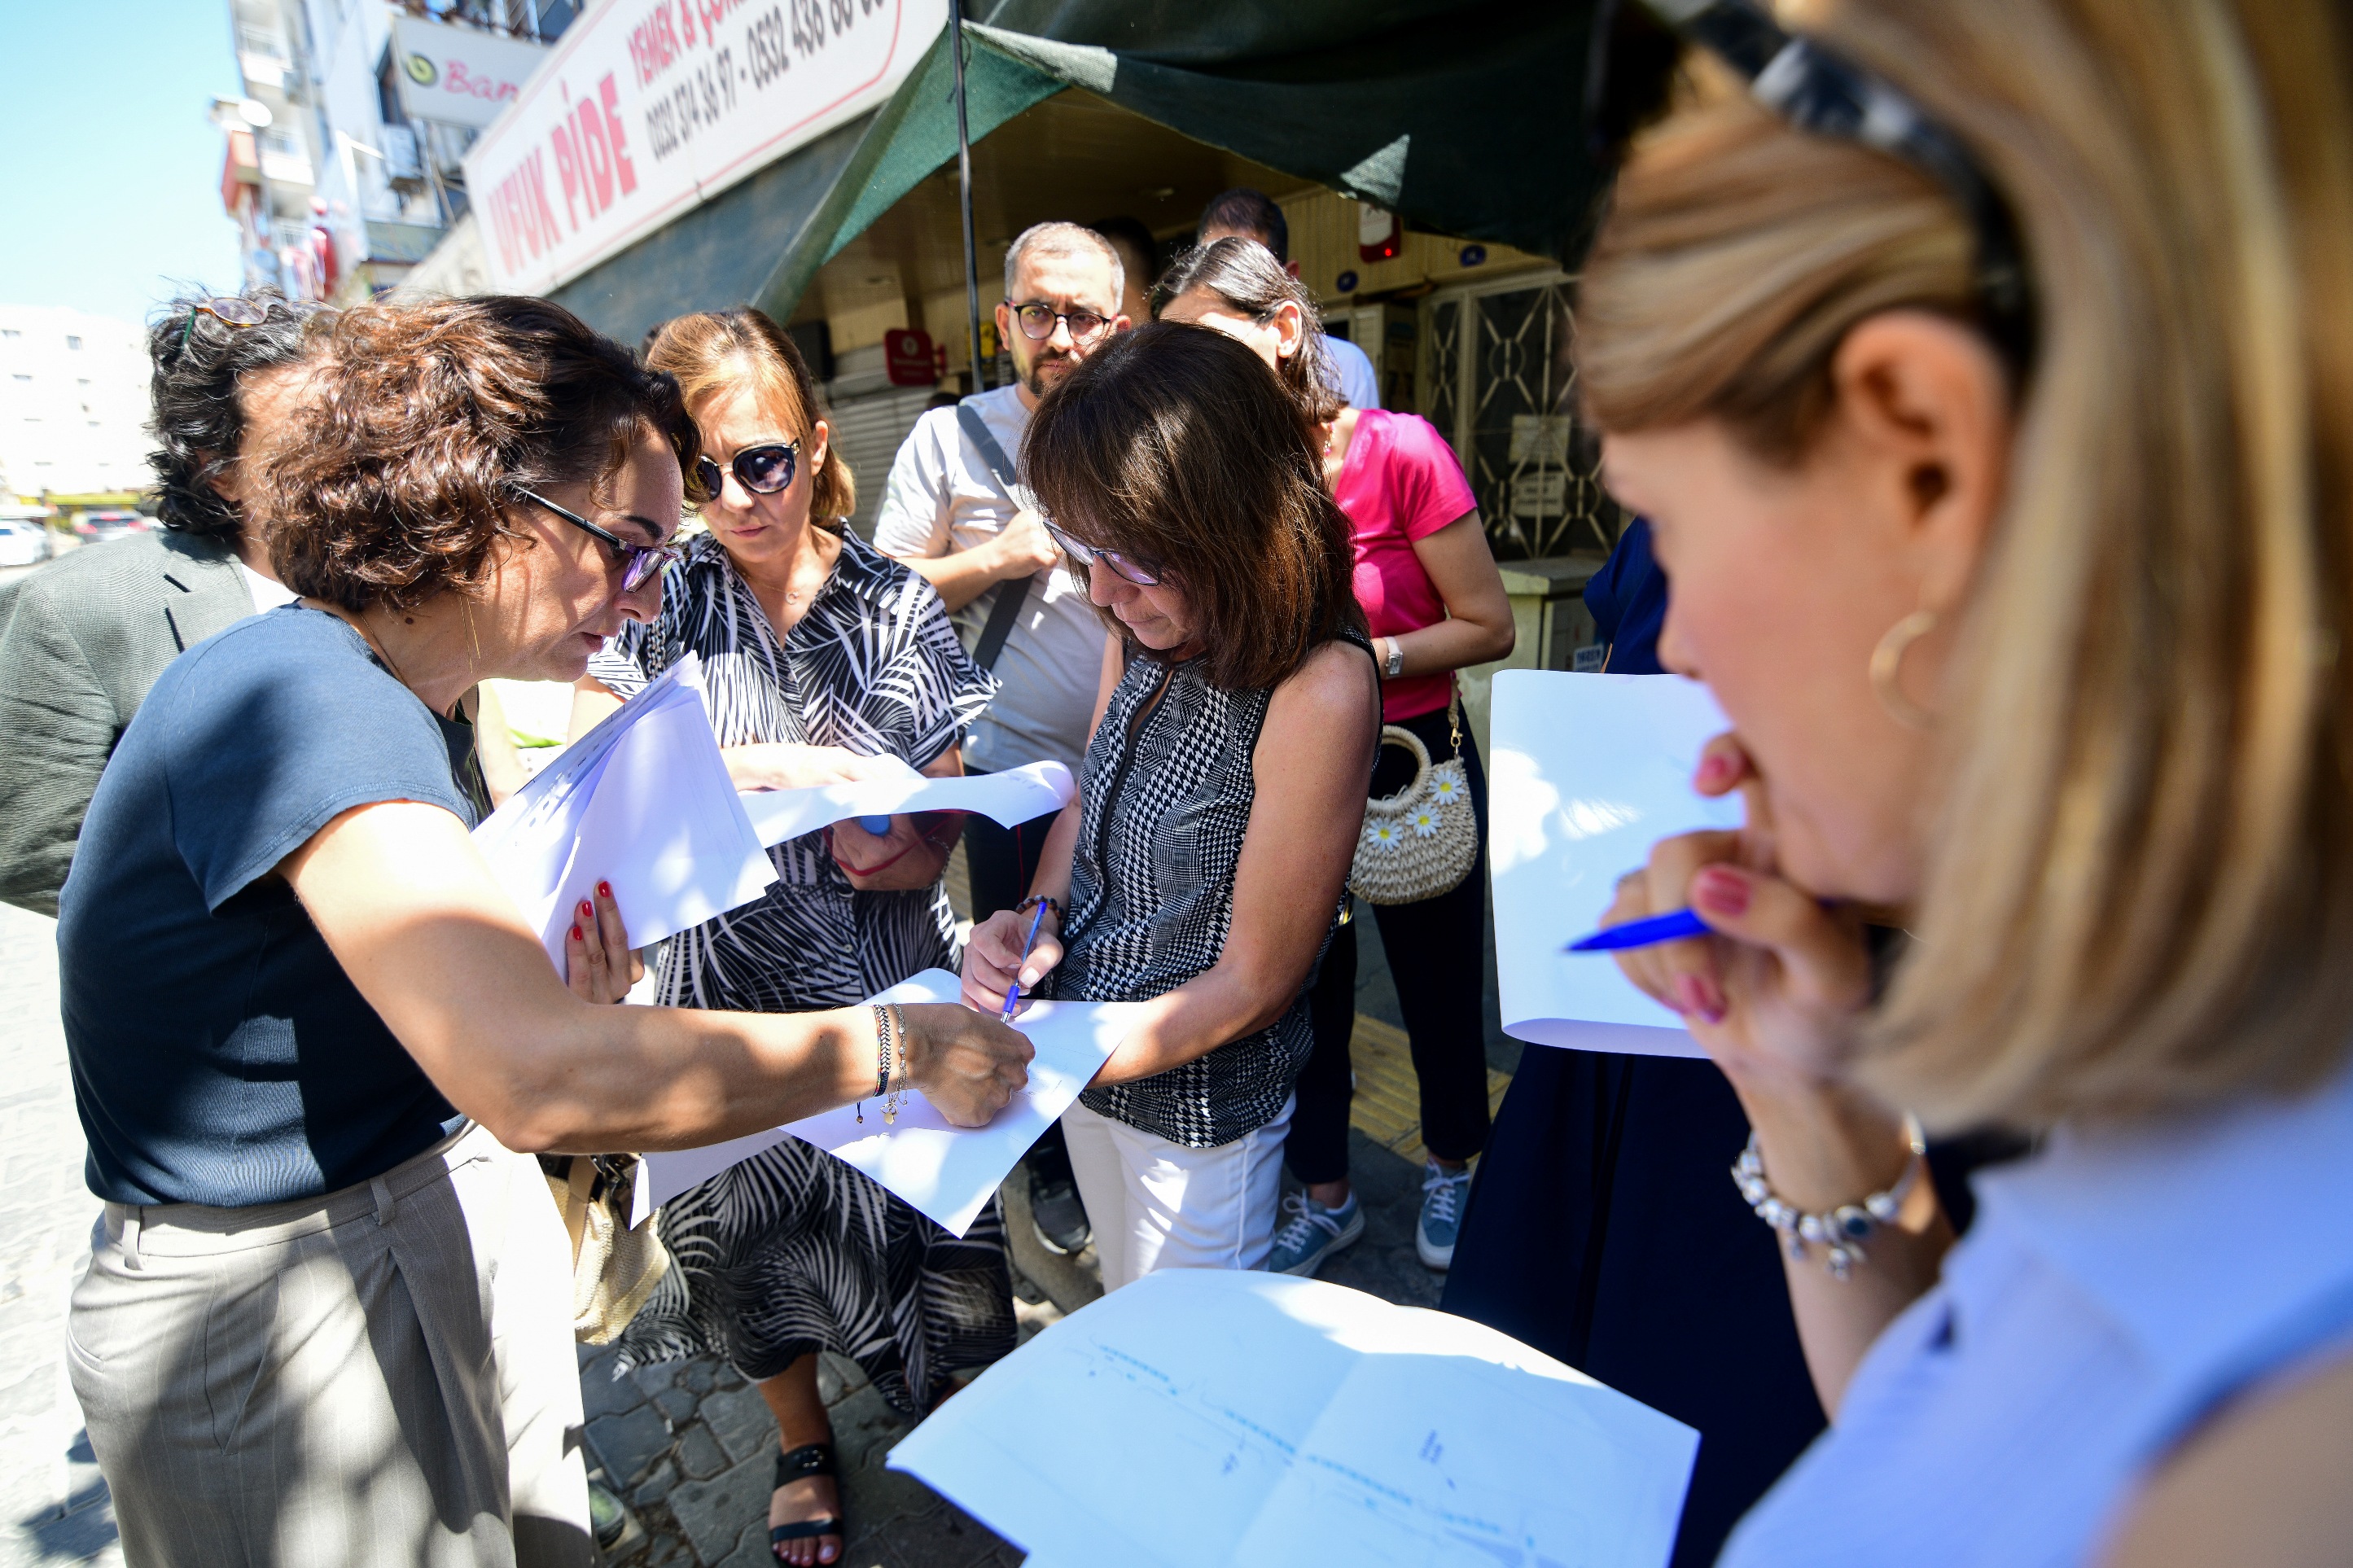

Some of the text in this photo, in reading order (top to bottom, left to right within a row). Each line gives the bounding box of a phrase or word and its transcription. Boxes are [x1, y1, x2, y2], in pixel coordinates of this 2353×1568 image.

[628, 0, 681, 90] YEMEK
[747, 6, 789, 90] 0532
[488, 72, 638, 277] UFUK PİDE
